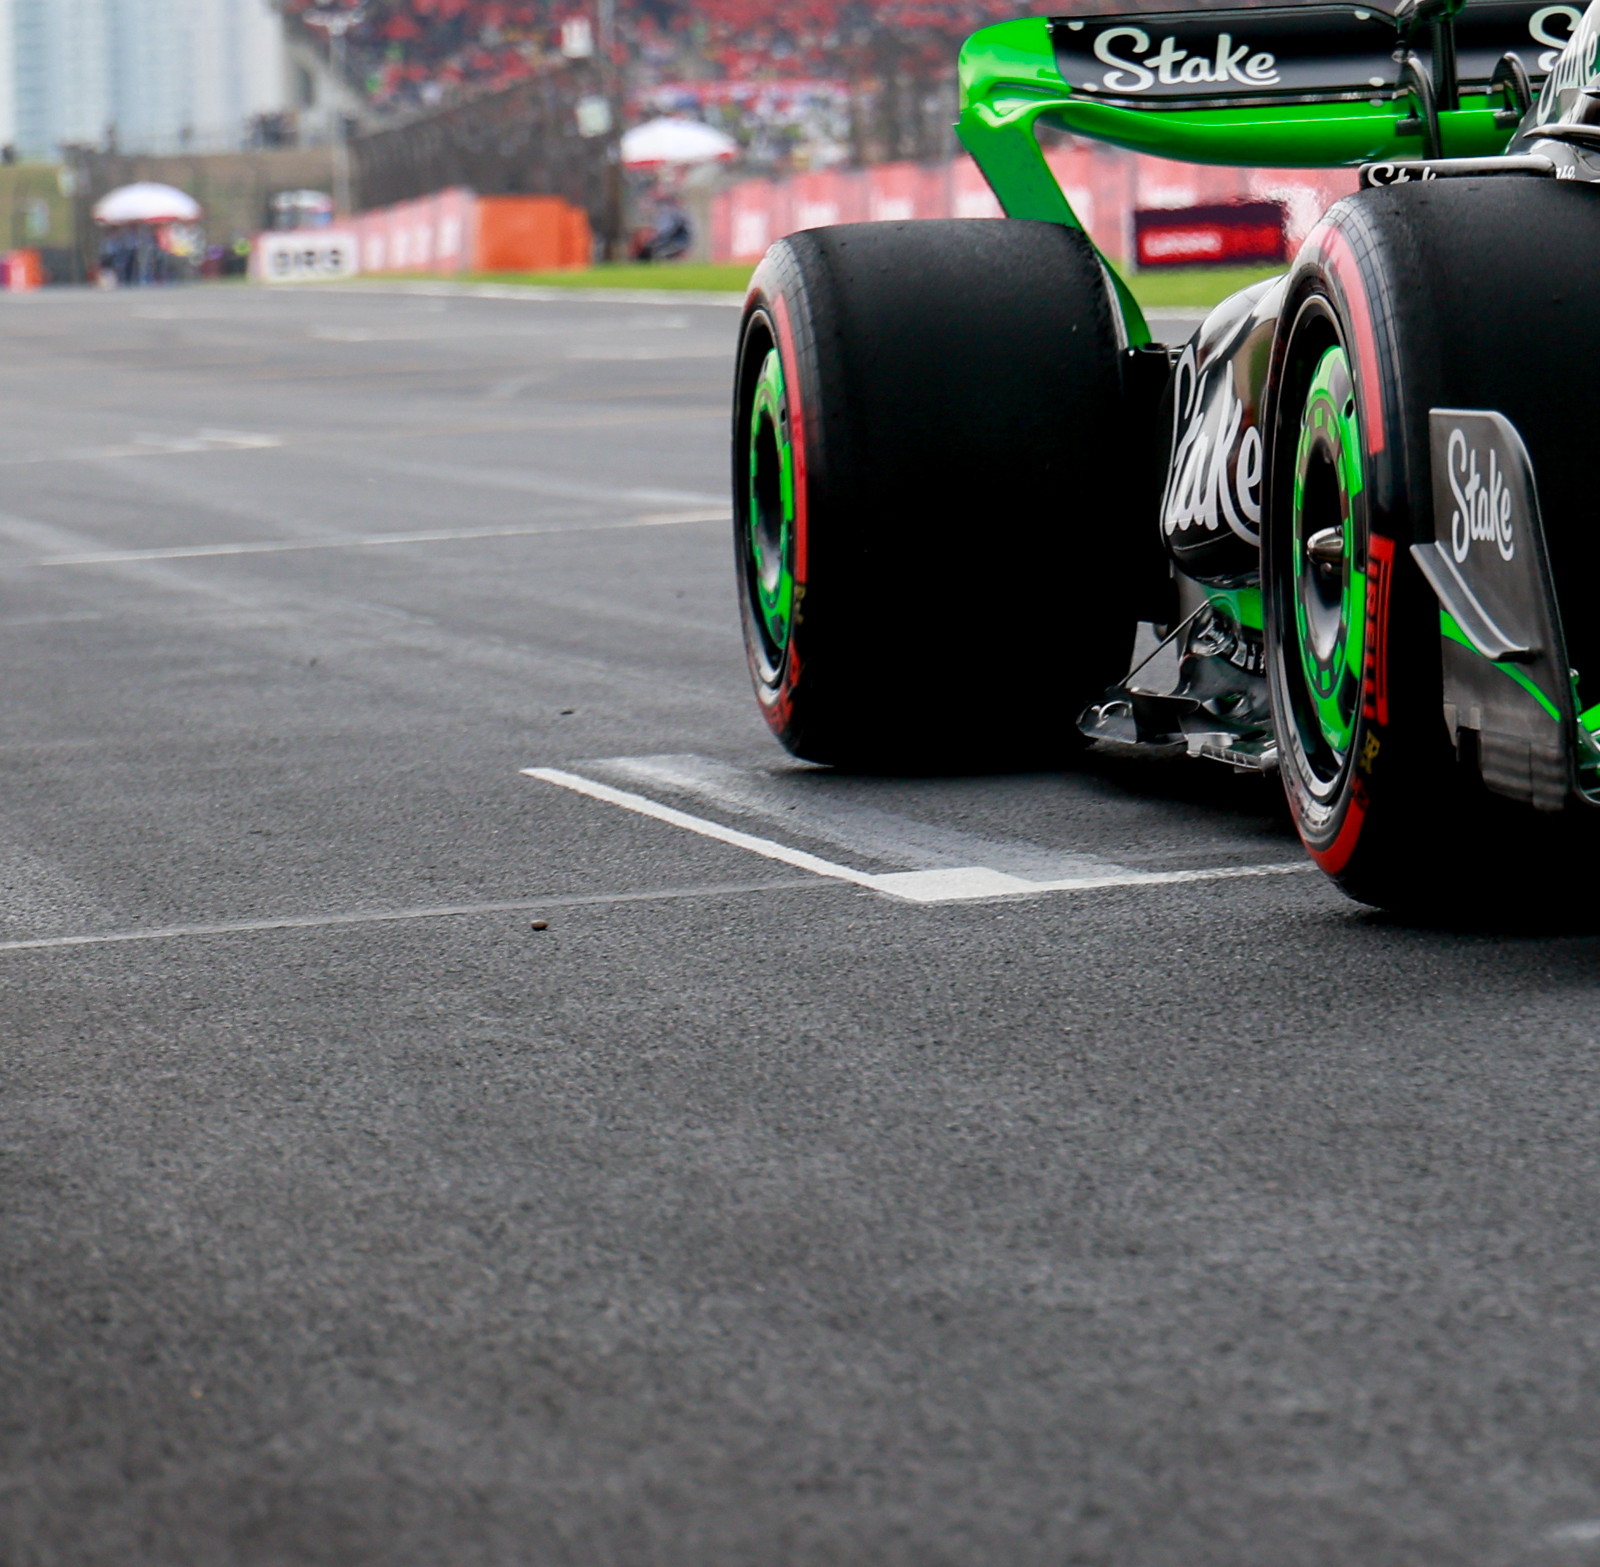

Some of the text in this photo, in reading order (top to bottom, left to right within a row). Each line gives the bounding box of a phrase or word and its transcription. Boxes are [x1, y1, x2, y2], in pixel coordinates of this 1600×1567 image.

[1092, 26, 1281, 93] Stake
[1159, 343, 1263, 548] Stake
[1447, 428, 1515, 564] Stake
[1363, 532, 1396, 727] PIRELLI
